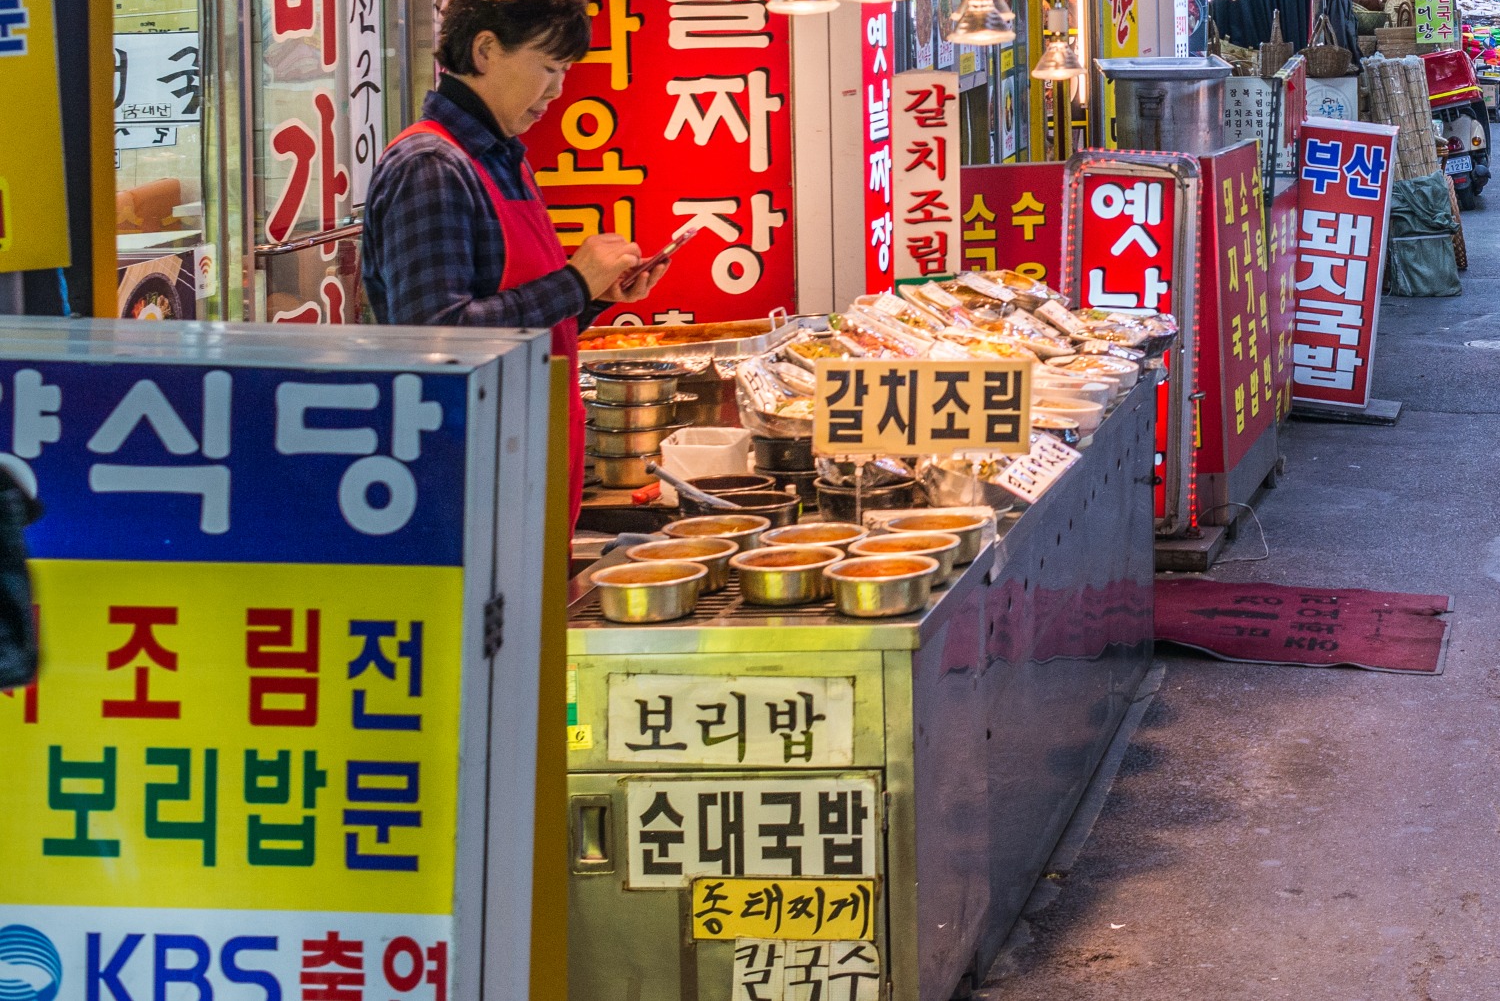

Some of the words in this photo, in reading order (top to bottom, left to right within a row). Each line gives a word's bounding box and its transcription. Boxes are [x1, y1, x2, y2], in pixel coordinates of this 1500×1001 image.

[123, 103, 170, 118] 국내산
[867, 12, 893, 273] 옛날짜장
[903, 83, 956, 276] 갈치조림
[1302, 139, 1387, 200] 부산
[1450, 162, 1469, 172] 1273
[1223, 177, 1245, 435] 돼지국밥
[1239, 172, 1260, 418] 소고기국밥
[1293, 209, 1373, 391] 돼지국밥
[825, 368, 1024, 446] 갈치조림
[342, 619, 424, 873] 전문
[625, 691, 826, 763] 보리밥
[42, 744, 328, 868] 보리밥
[639, 790, 868, 876] 순대국밥
[85, 931, 282, 1001] KBS
